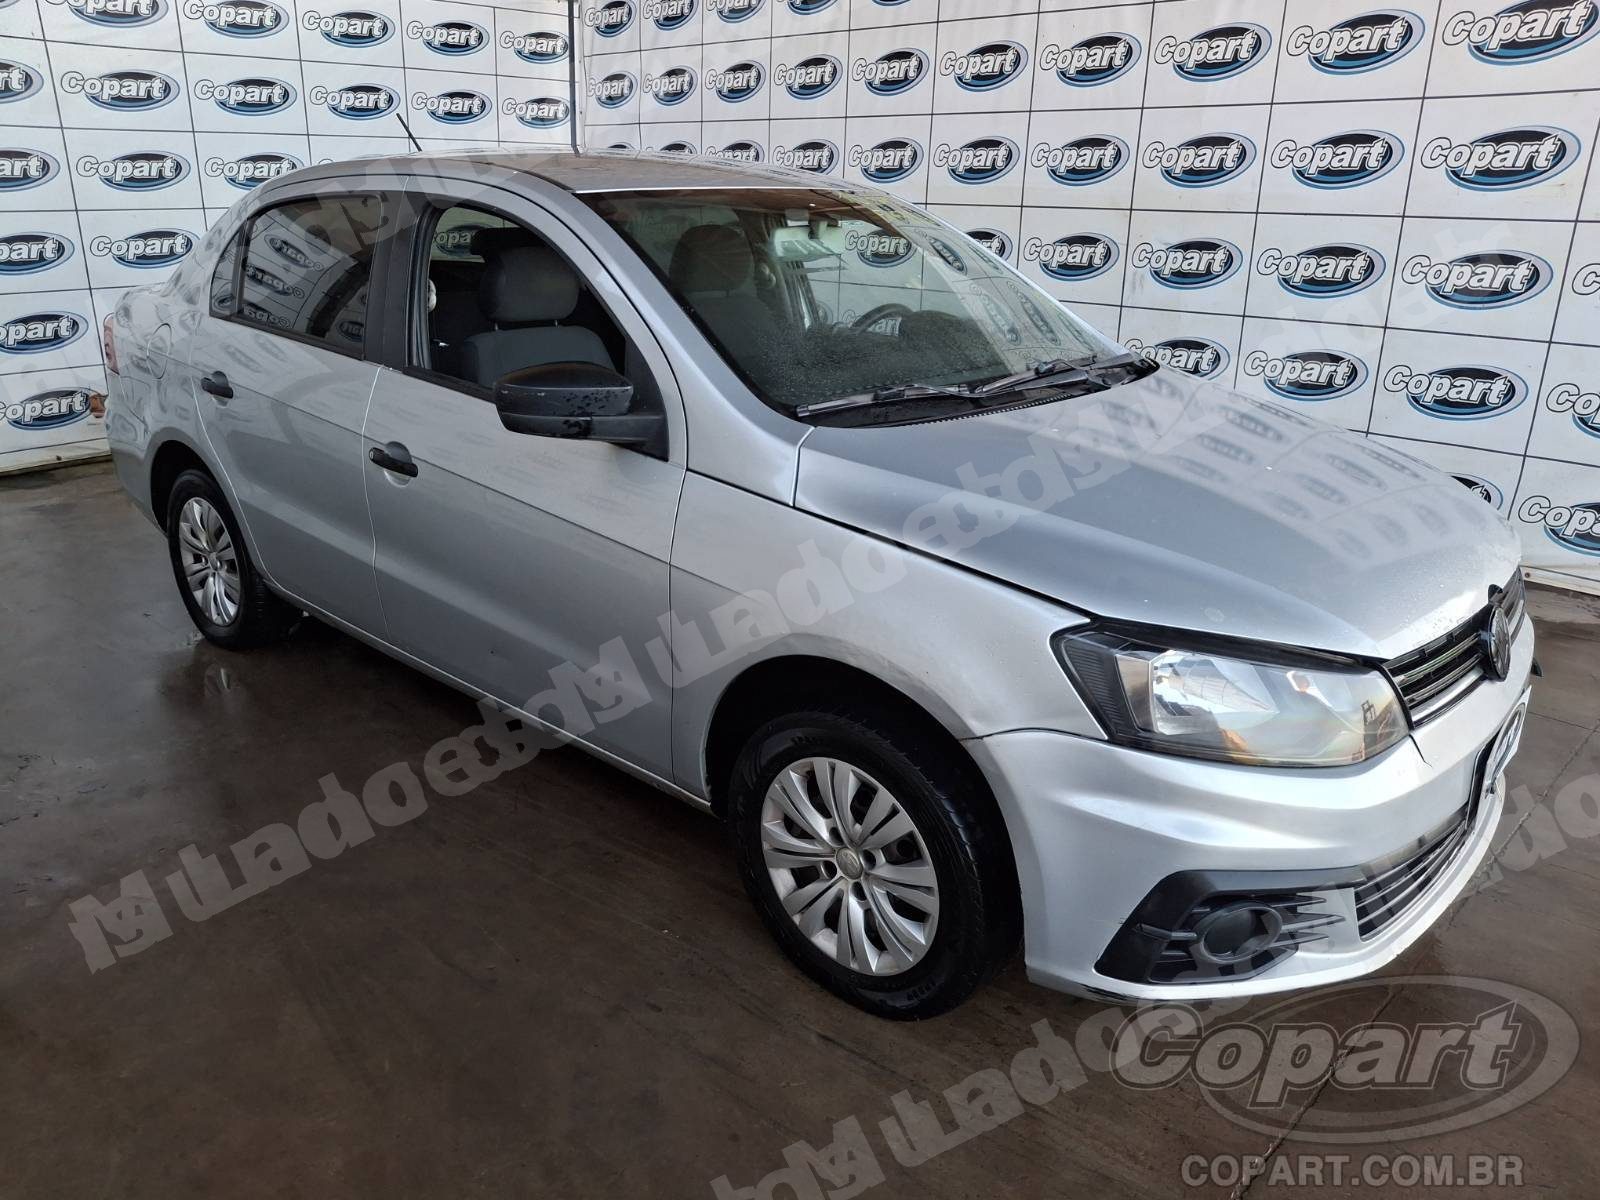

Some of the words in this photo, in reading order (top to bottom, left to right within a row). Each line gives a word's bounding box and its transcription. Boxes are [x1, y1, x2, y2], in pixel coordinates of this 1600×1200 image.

[45, 0, 153, 15] part
[184, 1, 276, 27] Copart
[584, 2, 629, 29] Copart
[643, 0, 691, 24] Copart
[302, 10, 384, 37] Copart
[406, 20, 479, 46] Copart
[1442, 0, 1592, 52] Copart
[499, 31, 565, 54] Copart
[1154, 29, 1256, 71] Copart
[1287, 17, 1407, 62] Copart
[852, 53, 920, 86] Copart
[940, 46, 1019, 82] Copart
[1040, 37, 1129, 76] Copart
[61, 71, 165, 100] Copart
[586, 75, 631, 101] Copart
[643, 71, 691, 93] Copart
[705, 65, 759, 93] Copart
[774, 59, 835, 91] Copart
[194, 79, 285, 105] Copart
[310, 86, 389, 109] Copart
[411, 92, 483, 114] Copart
[502, 98, 566, 120] Copart
[0, 154, 43, 178] art
[77, 155, 176, 182] Copart
[205, 157, 293, 180] Copart
[773, 145, 831, 169] Copart
[848, 143, 917, 173] Copart
[934, 142, 1010, 174] Copart
[1031, 141, 1119, 176] Copart
[1142, 139, 1242, 176] Copart
[1271, 138, 1389, 176] Copart
[1421, 134, 1561, 177] Copart
[90, 233, 186, 261] Copart
[845, 229, 909, 257] Copart
[1023, 237, 1108, 268] Copart
[1132, 243, 1229, 276] Copart
[1257, 248, 1369, 284] Copart
[1402, 255, 1535, 293] Copart
[0, 315, 73, 347] part
[1244, 351, 1354, 387] Copart
[1384, 365, 1510, 405] Copart
[0, 391, 86, 424] opart
[1518, 495, 1600, 537] Cop
